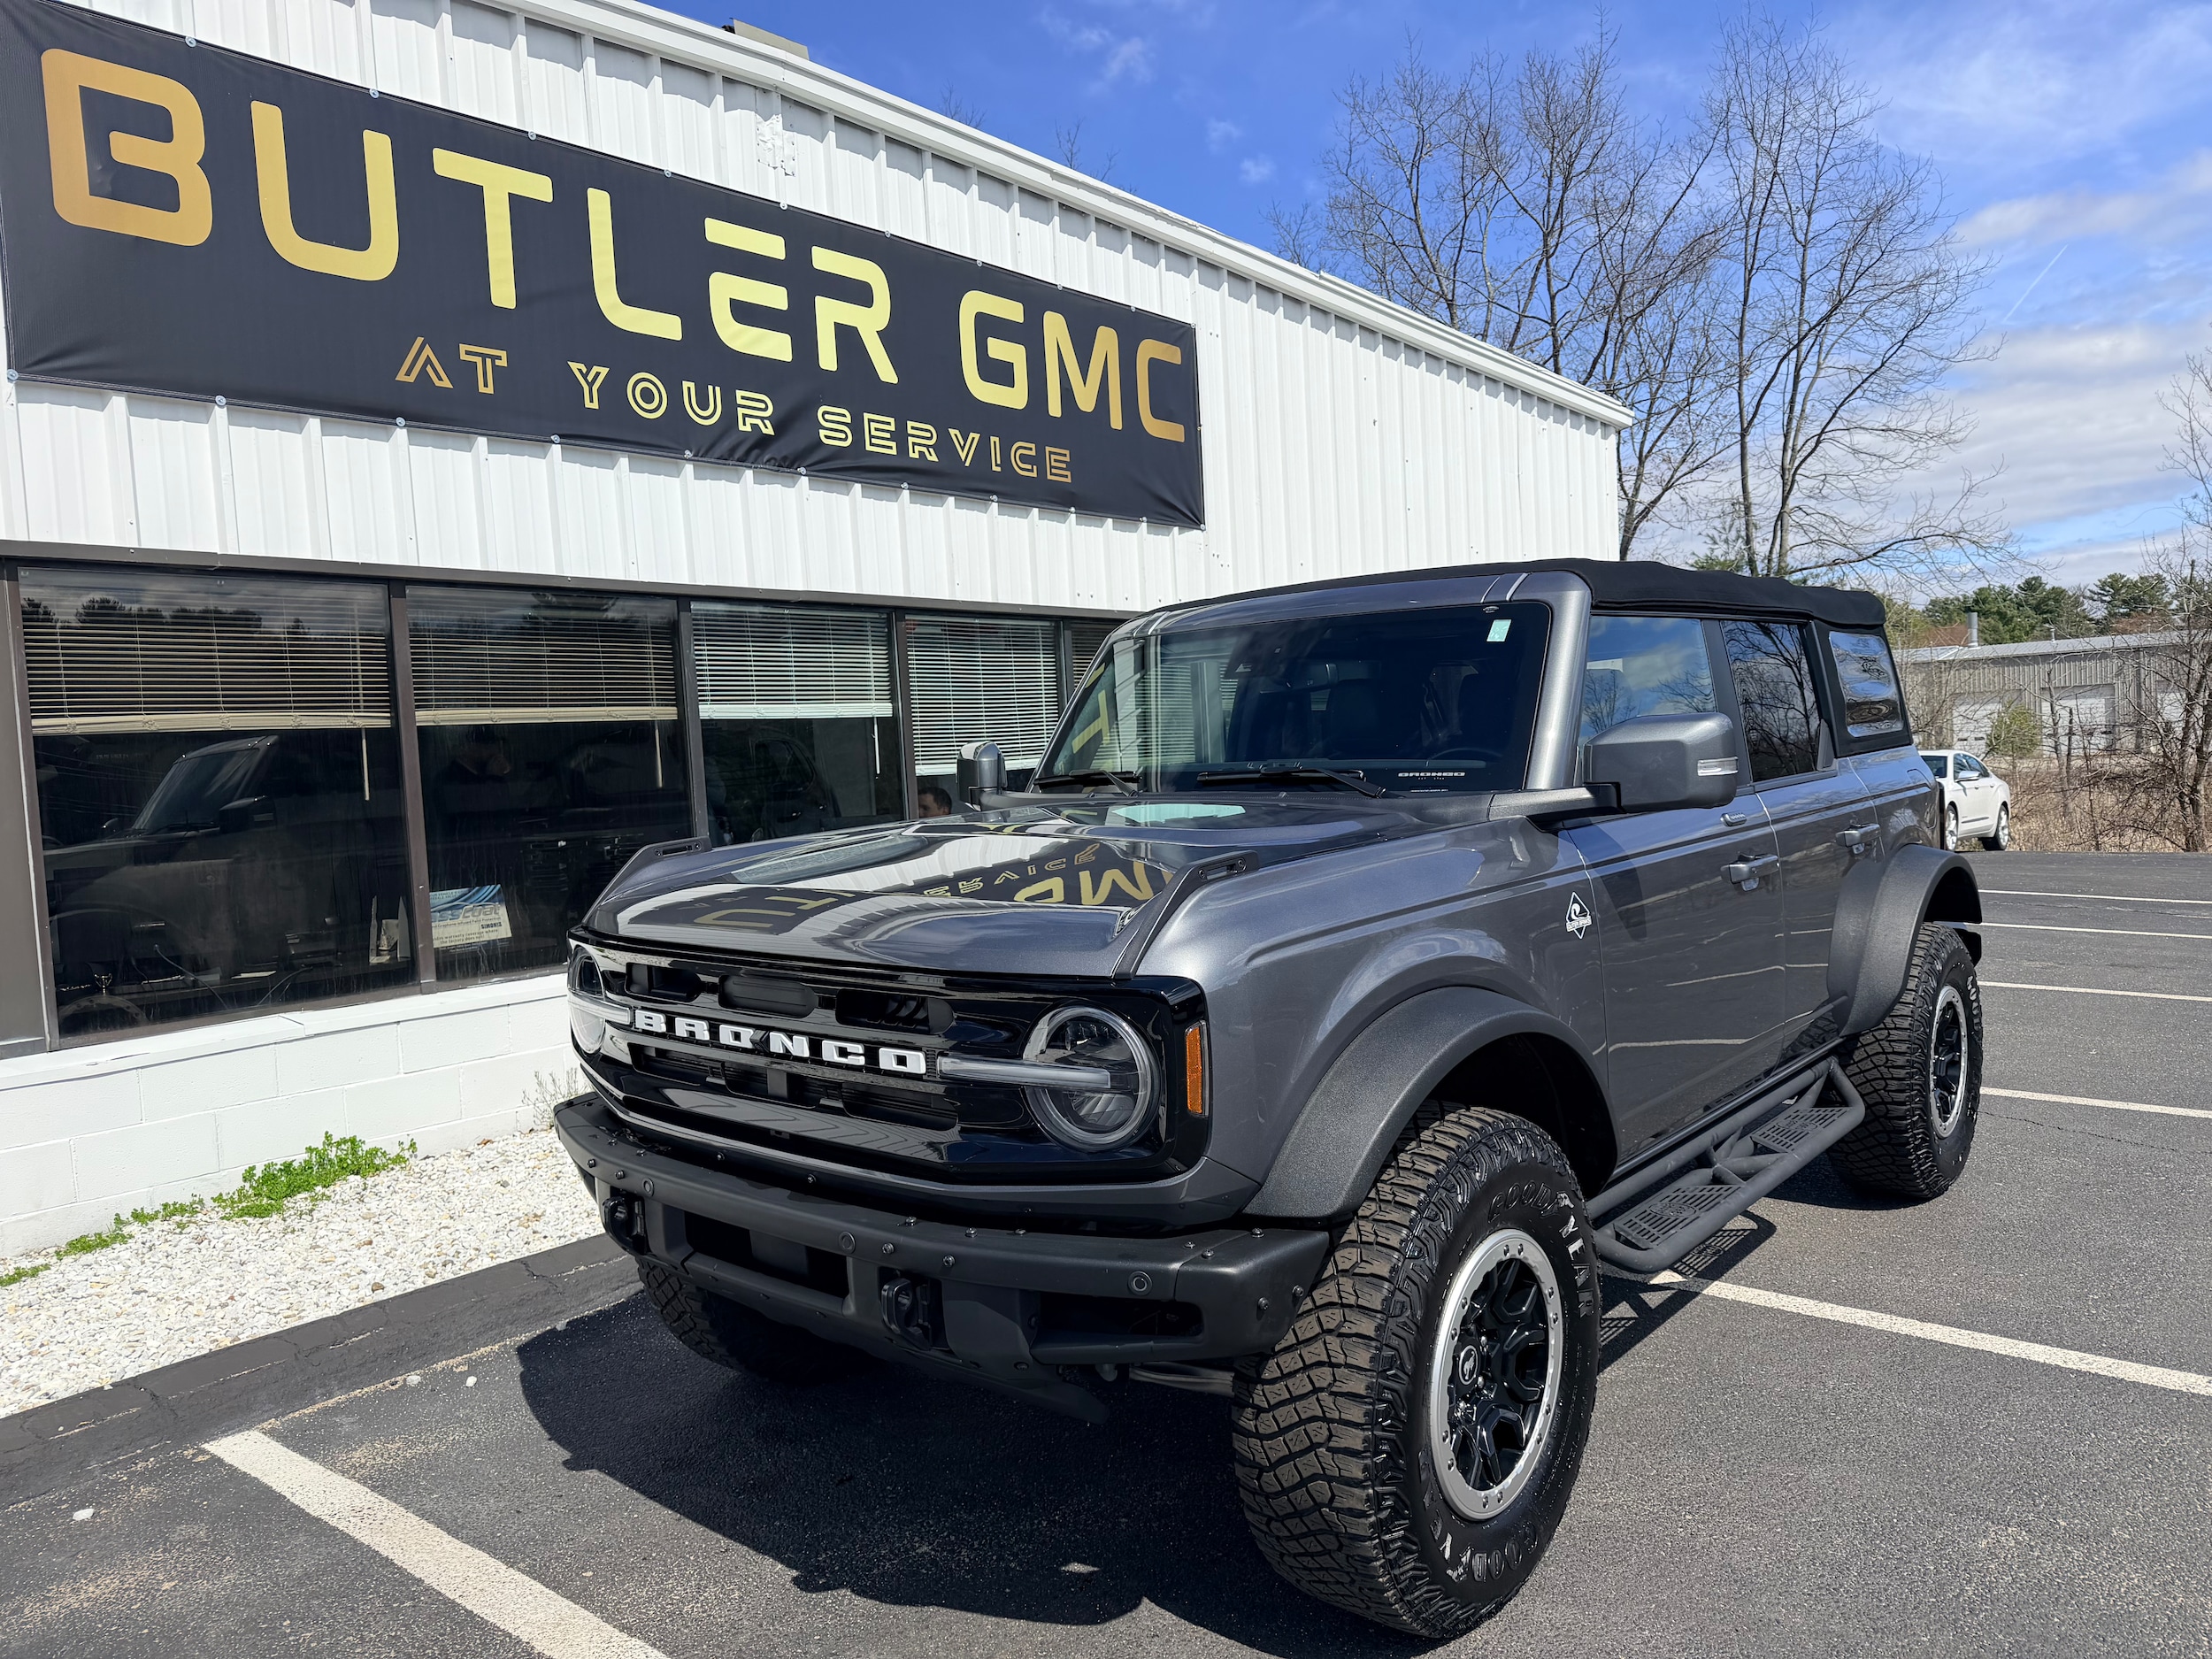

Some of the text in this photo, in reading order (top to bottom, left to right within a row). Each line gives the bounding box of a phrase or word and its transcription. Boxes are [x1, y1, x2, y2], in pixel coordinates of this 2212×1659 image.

[42, 49, 1186, 443] BUTLER GMC
[396, 336, 1072, 483] AT YOUR SERVICE
[635, 1009, 926, 1075] BRONCO
